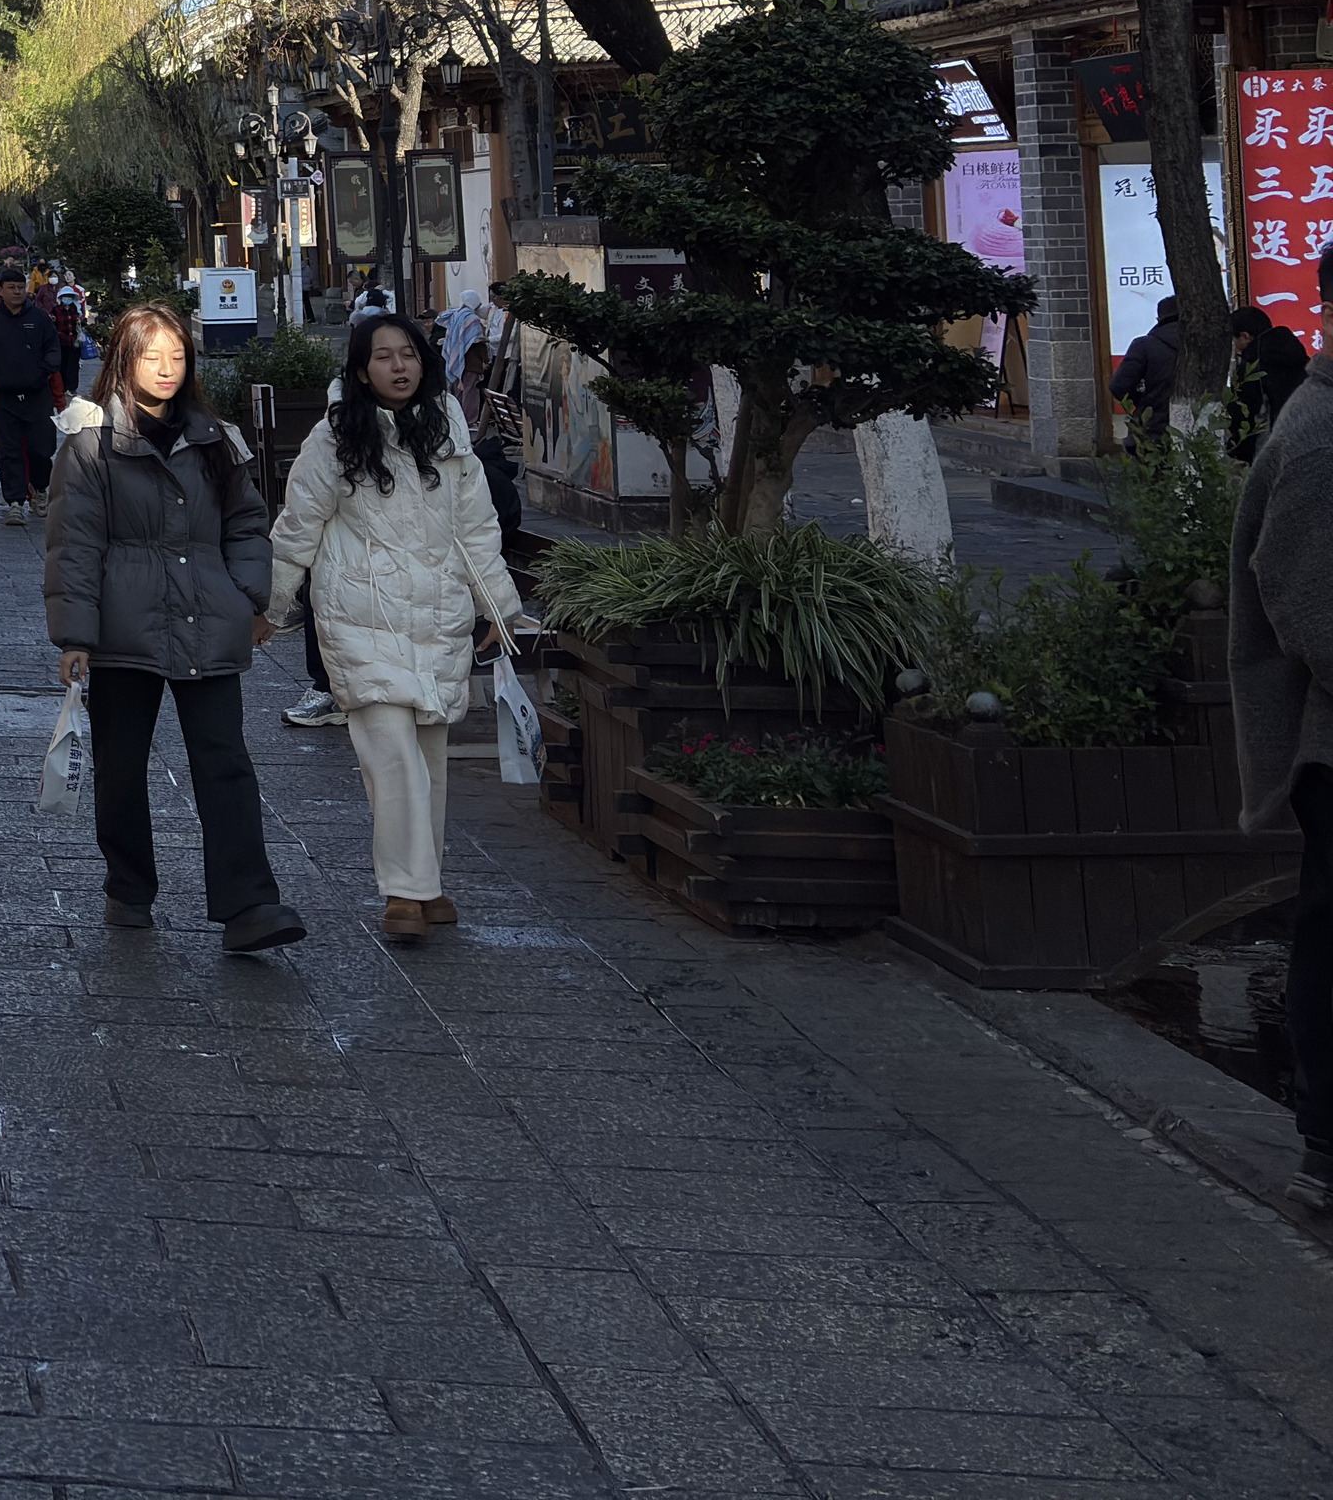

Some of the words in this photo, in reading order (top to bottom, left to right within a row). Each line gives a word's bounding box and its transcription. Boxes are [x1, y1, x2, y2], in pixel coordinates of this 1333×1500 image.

[962, 162, 1020, 176] 白桃鲜花
[1245, 106, 1302, 307] 买三送一
[1119, 265, 1165, 288] 品质
